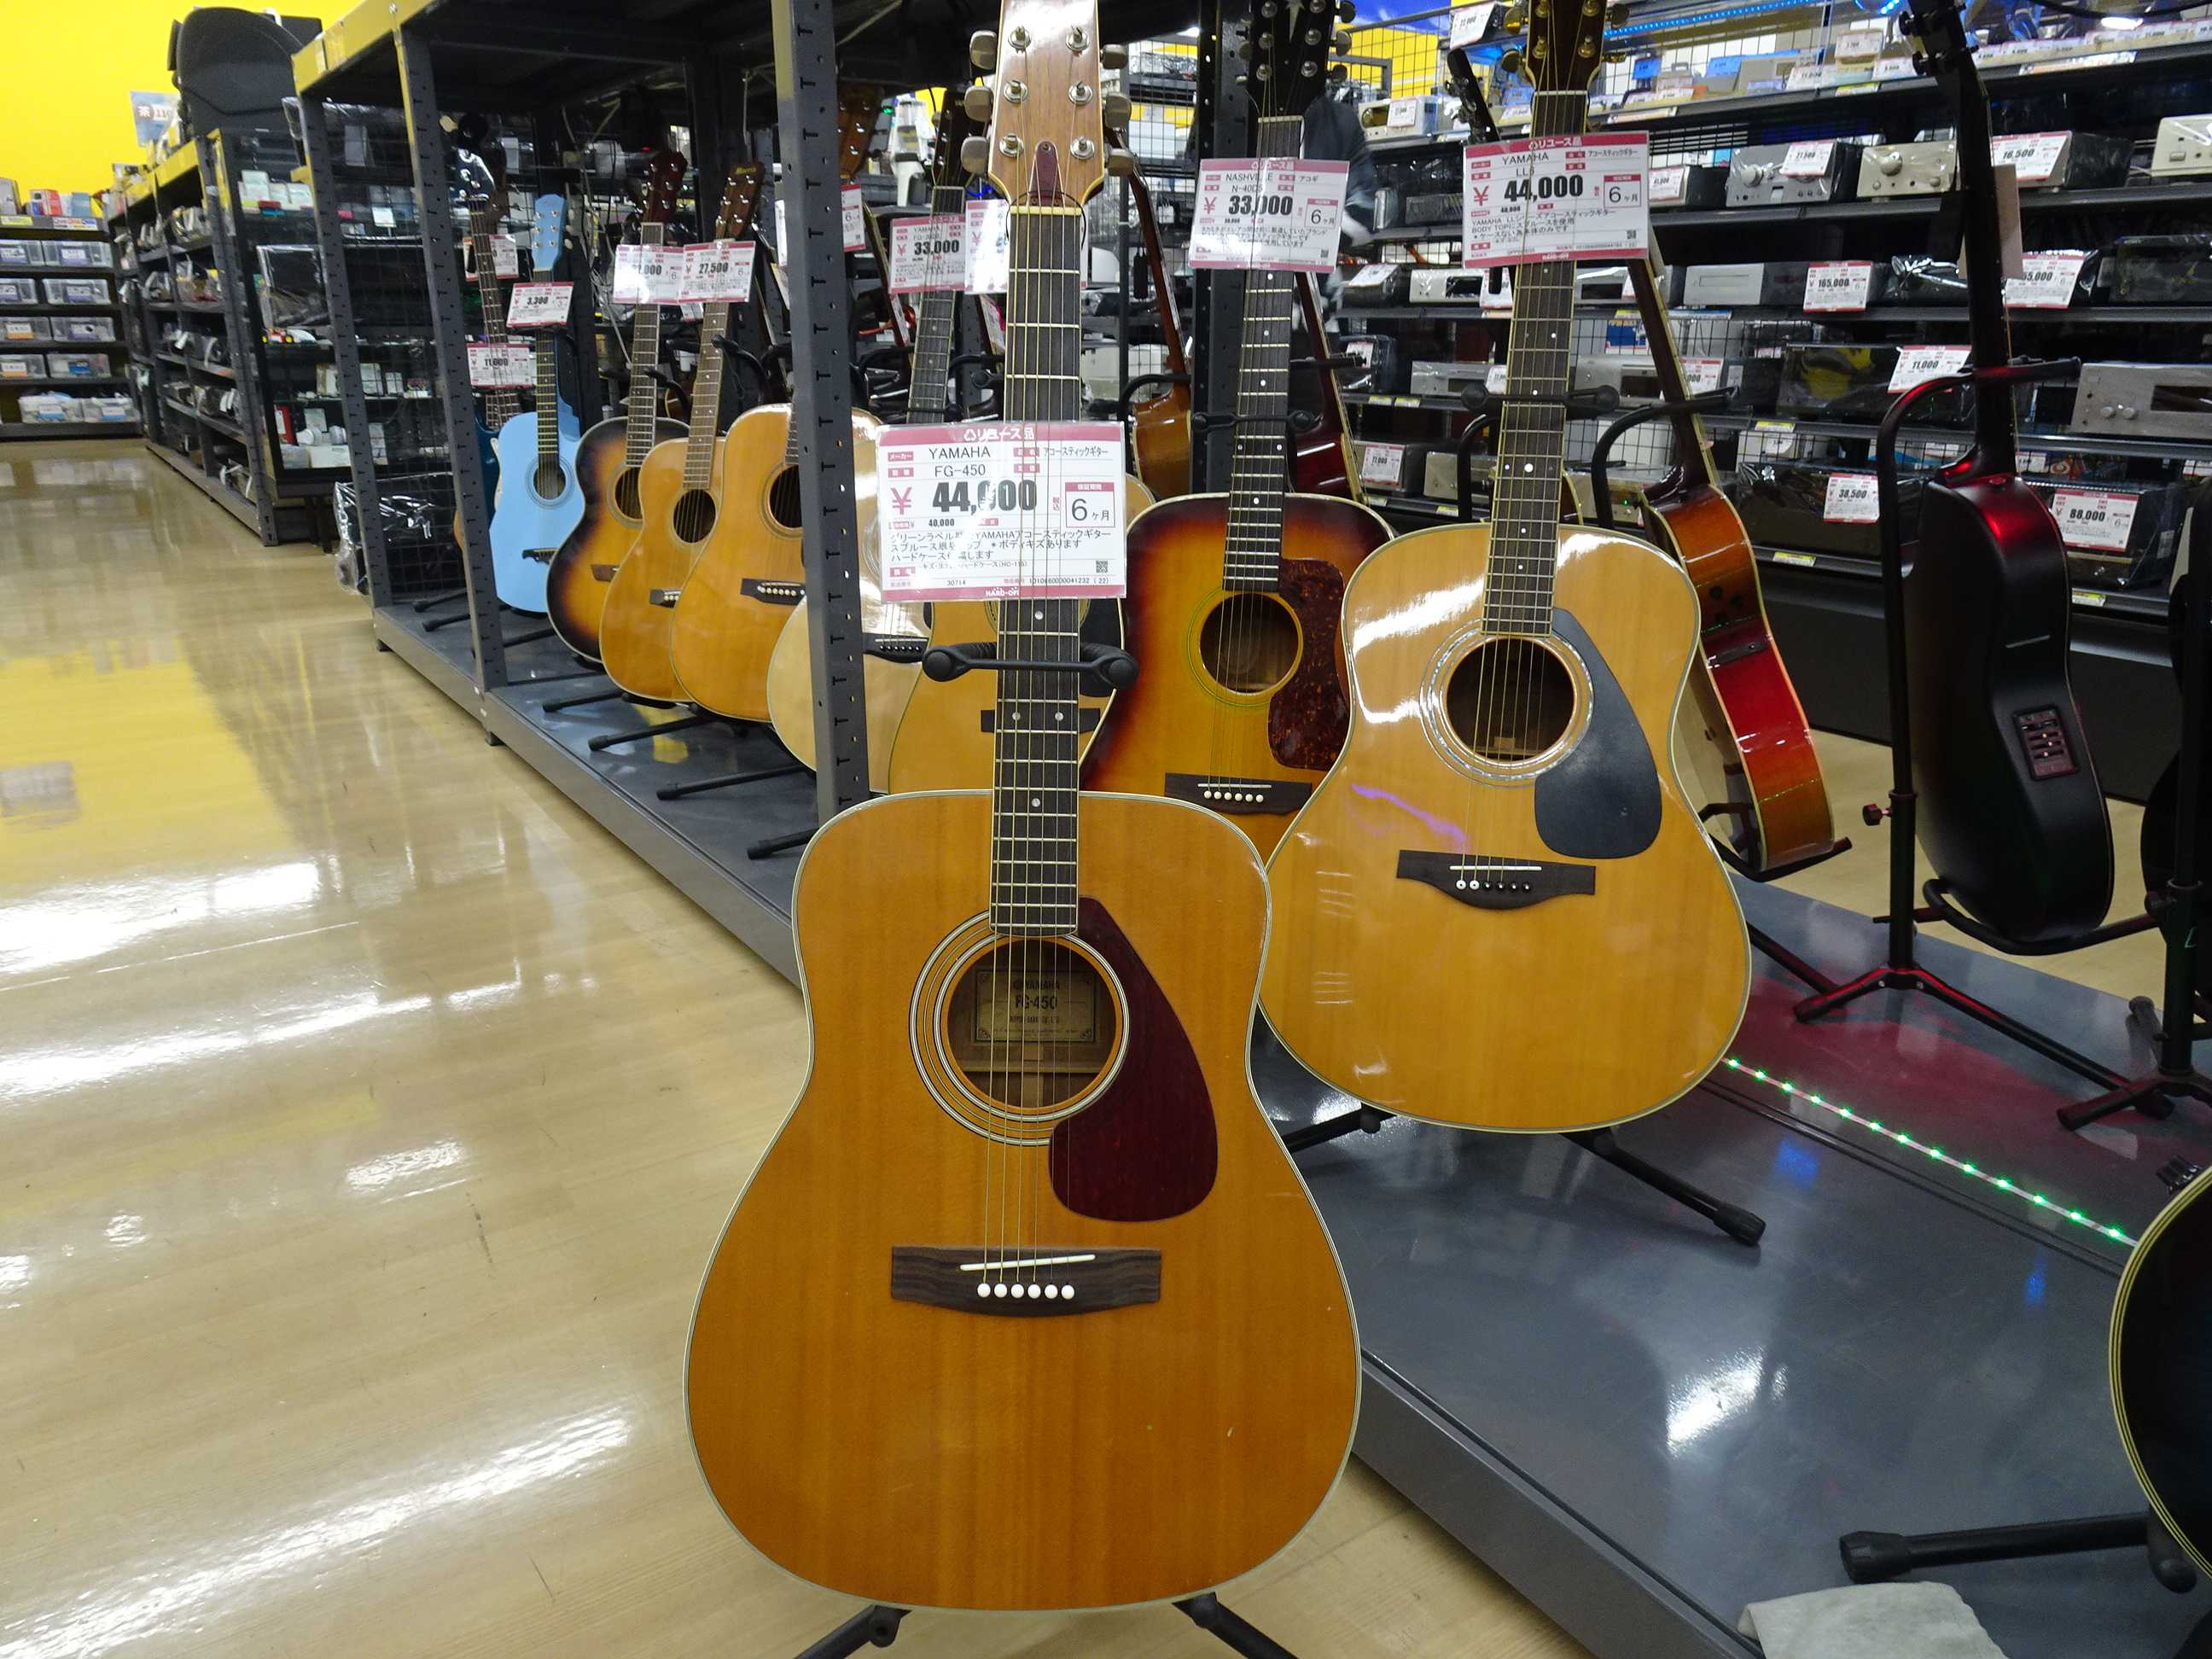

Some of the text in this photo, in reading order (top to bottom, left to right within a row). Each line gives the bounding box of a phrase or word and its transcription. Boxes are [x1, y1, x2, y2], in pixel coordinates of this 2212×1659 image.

[1503, 152, 1550, 165] YAMAHA
[1225, 173, 1273, 183] NASHVIE
[1505, 174, 1583, 204] 44,000
[1228, 195, 1295, 217] 33,000
[1818, 278, 1850, 288] 165,000
[928, 445, 991, 460] YAMAHA
[1043, 445, 1109, 457] アコースティックギター
[934, 463, 987, 478] FG-450
[932, 478, 1039, 516] 44,000
[2069, 508, 2106, 522] 88,000
[928, 518, 956, 528] 40,000
[1015, 994, 1058, 1010] FG-450
